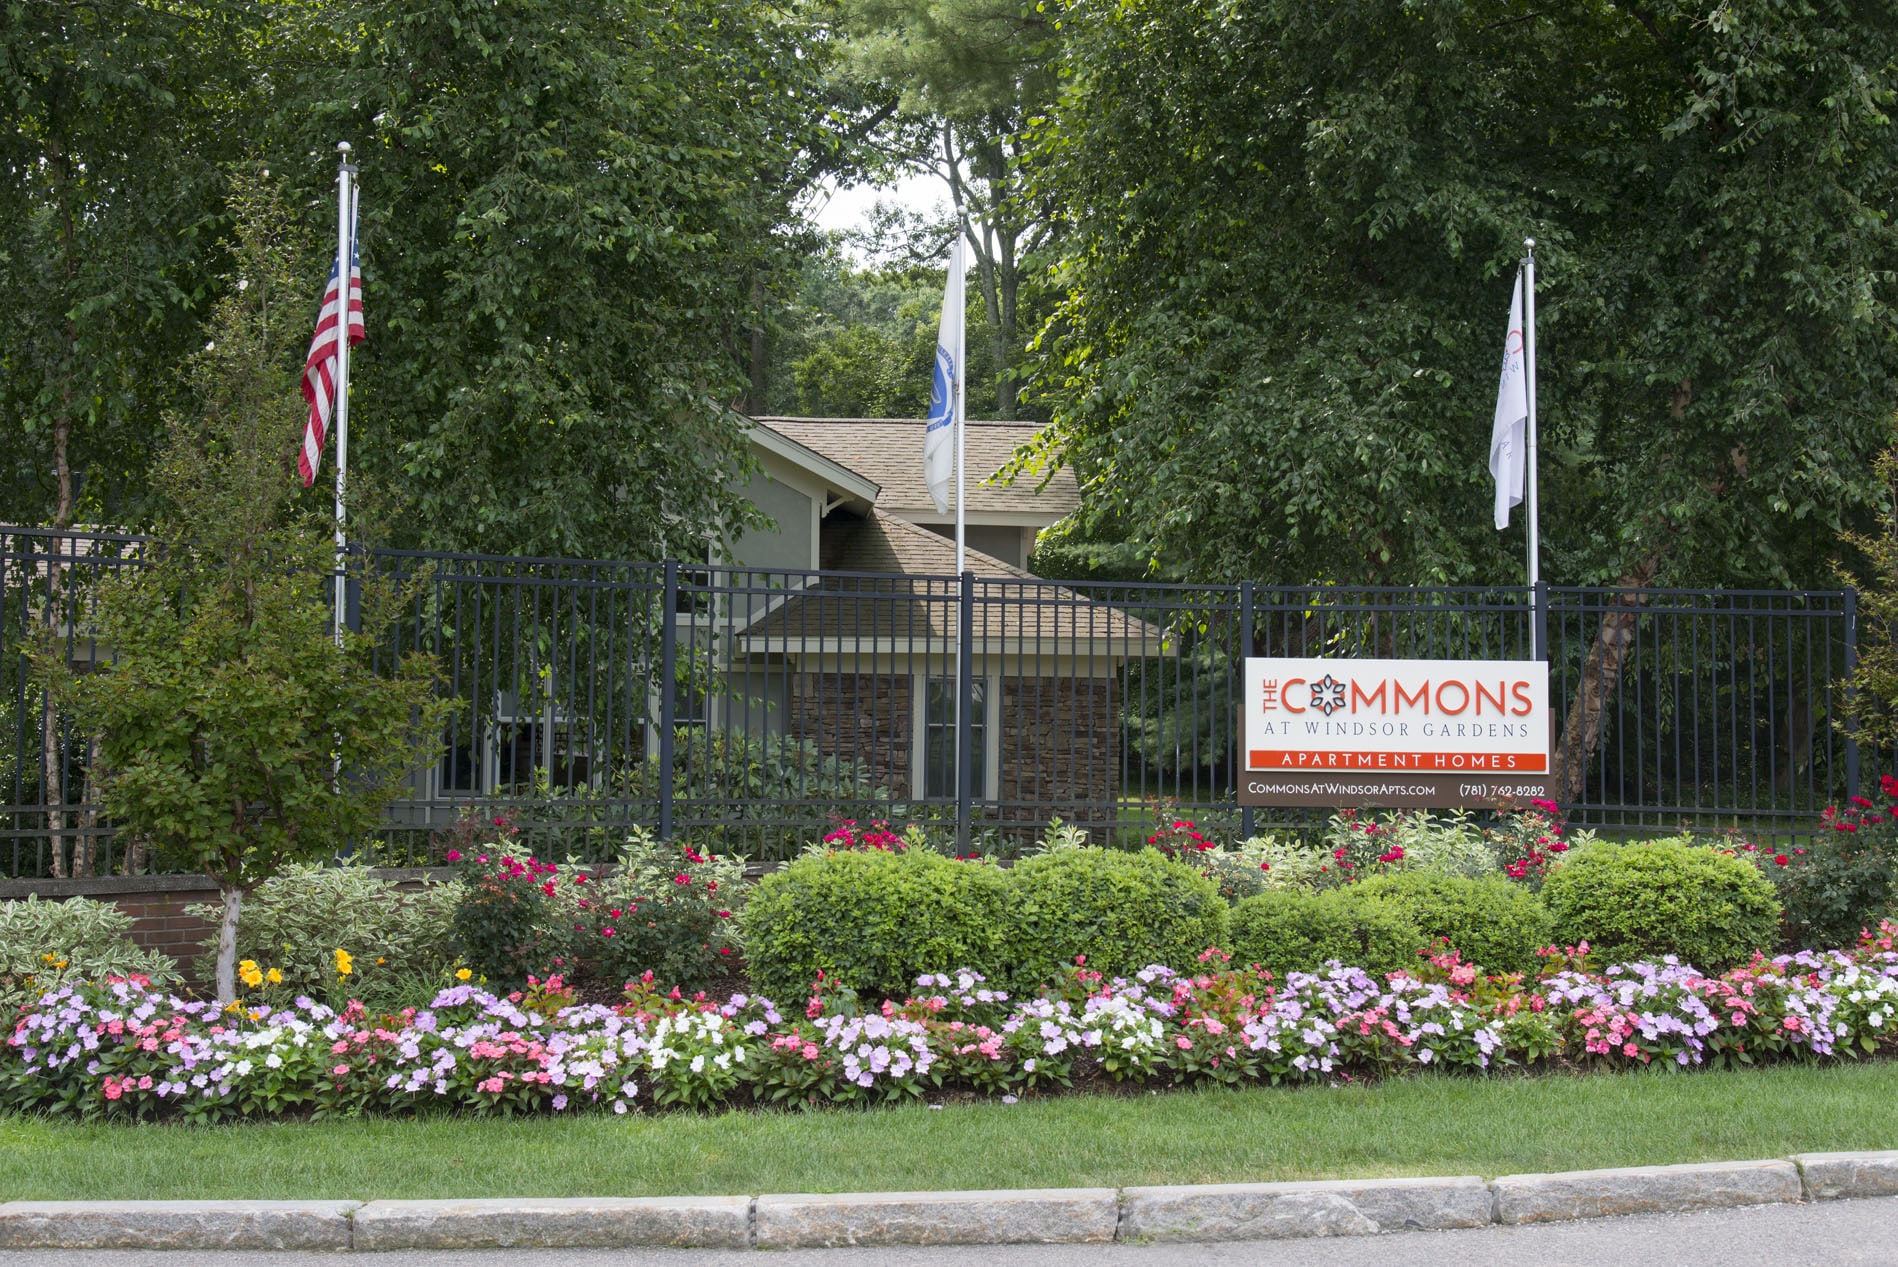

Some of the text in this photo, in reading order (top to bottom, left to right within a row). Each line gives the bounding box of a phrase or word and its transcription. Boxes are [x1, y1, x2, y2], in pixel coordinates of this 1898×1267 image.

[1262, 678, 1278, 714] THE
[1280, 674, 1533, 717] COMMONS
[1264, 721, 1529, 738] AT WINDSOR GARDENS
[1281, 752, 1517, 769] APARTMENT HOMES
[1459, 784, 1487, 797] (781)
[1491, 784, 1545, 797] 762-8282
